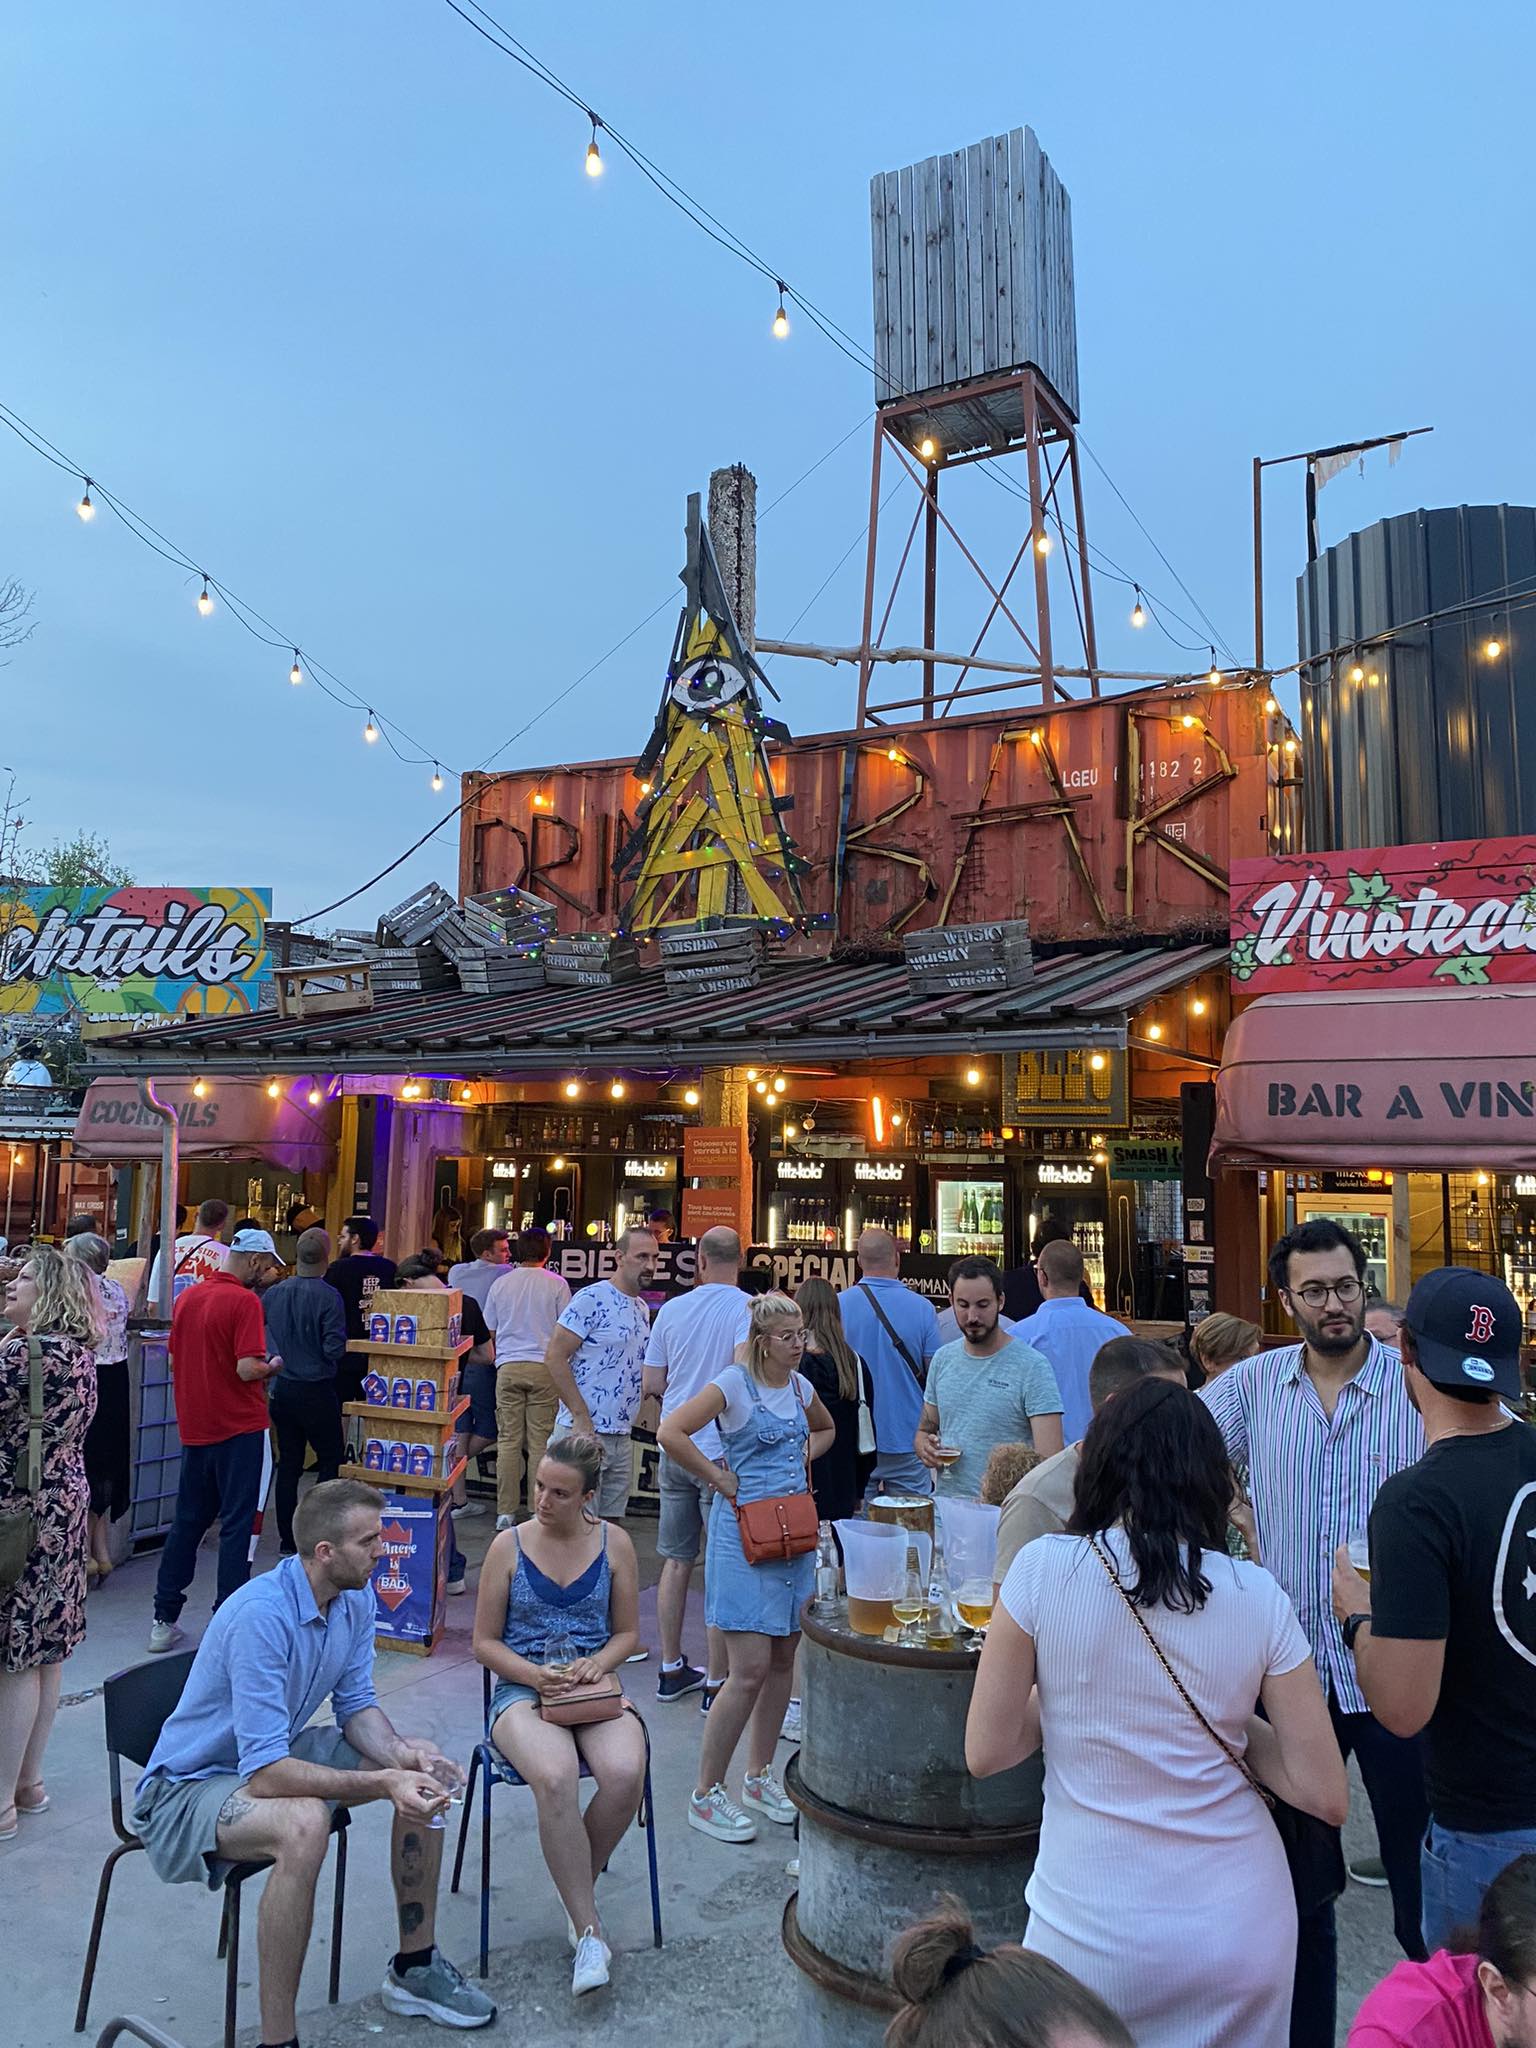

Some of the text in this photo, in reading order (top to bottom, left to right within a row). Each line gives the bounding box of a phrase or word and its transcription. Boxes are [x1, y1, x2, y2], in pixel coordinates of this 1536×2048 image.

[1062, 767, 1098, 788] LGEU
[943, 926, 1004, 946] WHISKY
[572, 943, 605, 955] RHUM
[547, 954, 578, 969] RHUM
[906, 946, 969, 971] WHISKY
[578, 972, 610, 984] RHUM
[946, 967, 1007, 988] WHISKY
[1267, 1081, 1534, 1120] BAR A VIN
[722, 1146, 728, 1154] à
[729, 1146, 737, 1154] la
[1113, 1146, 1169, 1162] SMASH
[624, 1159, 668, 1177] fritz-kola
[777, 1162, 825, 1179] fritz-kola
[854, 1162, 905, 1181] fritz-kola
[1038, 1164, 1095, 1184] fritz-kola
[198, 1246, 220, 1261] SIDE
[362, 1277, 380, 1287] KEEP
[1465, 1304, 1496, 1343] B
[390, 1558, 399, 1570] is
[381, 1577, 407, 1590] BAD
